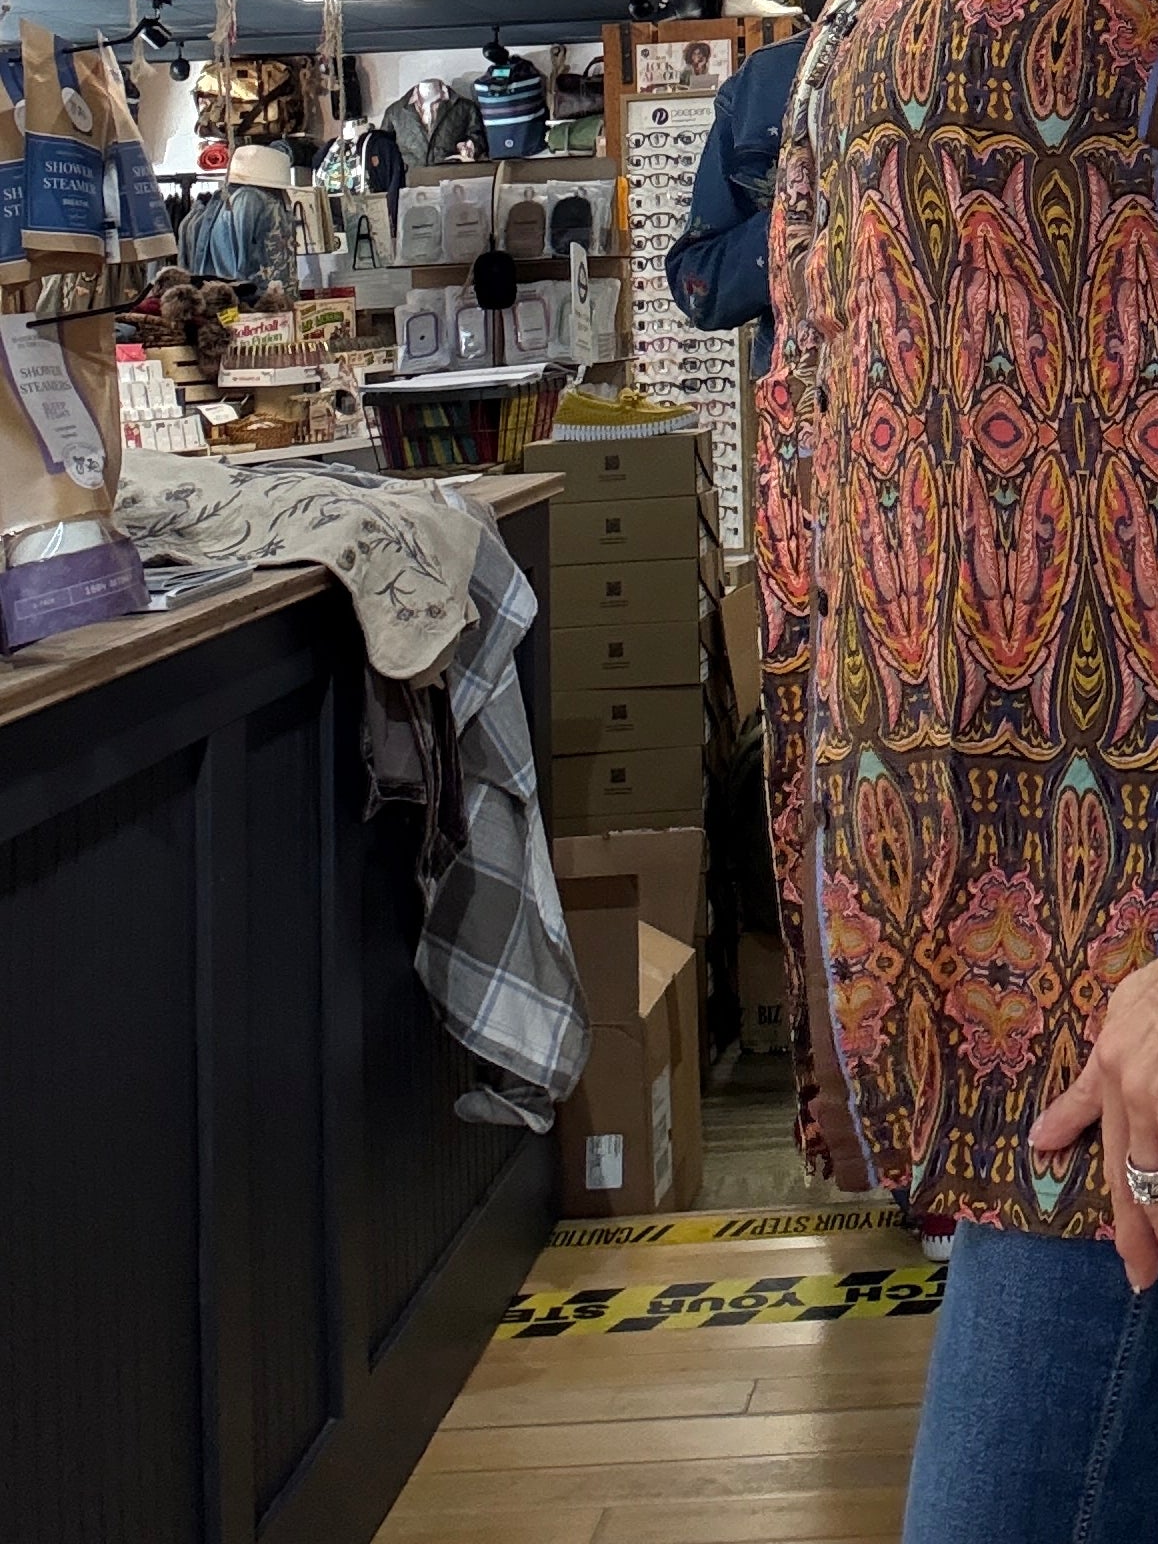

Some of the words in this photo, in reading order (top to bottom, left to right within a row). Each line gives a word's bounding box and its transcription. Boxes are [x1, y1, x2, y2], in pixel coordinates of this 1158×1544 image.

[44, 160, 94, 180] SHOWER
[750, 1215, 816, 1237] STEP
[817, 1213, 878, 1234] YOUR
[646, 1289, 808, 1316] YOUR
[843, 1282, 945, 1304] TCH
[503, 1301, 610, 1325] STE
